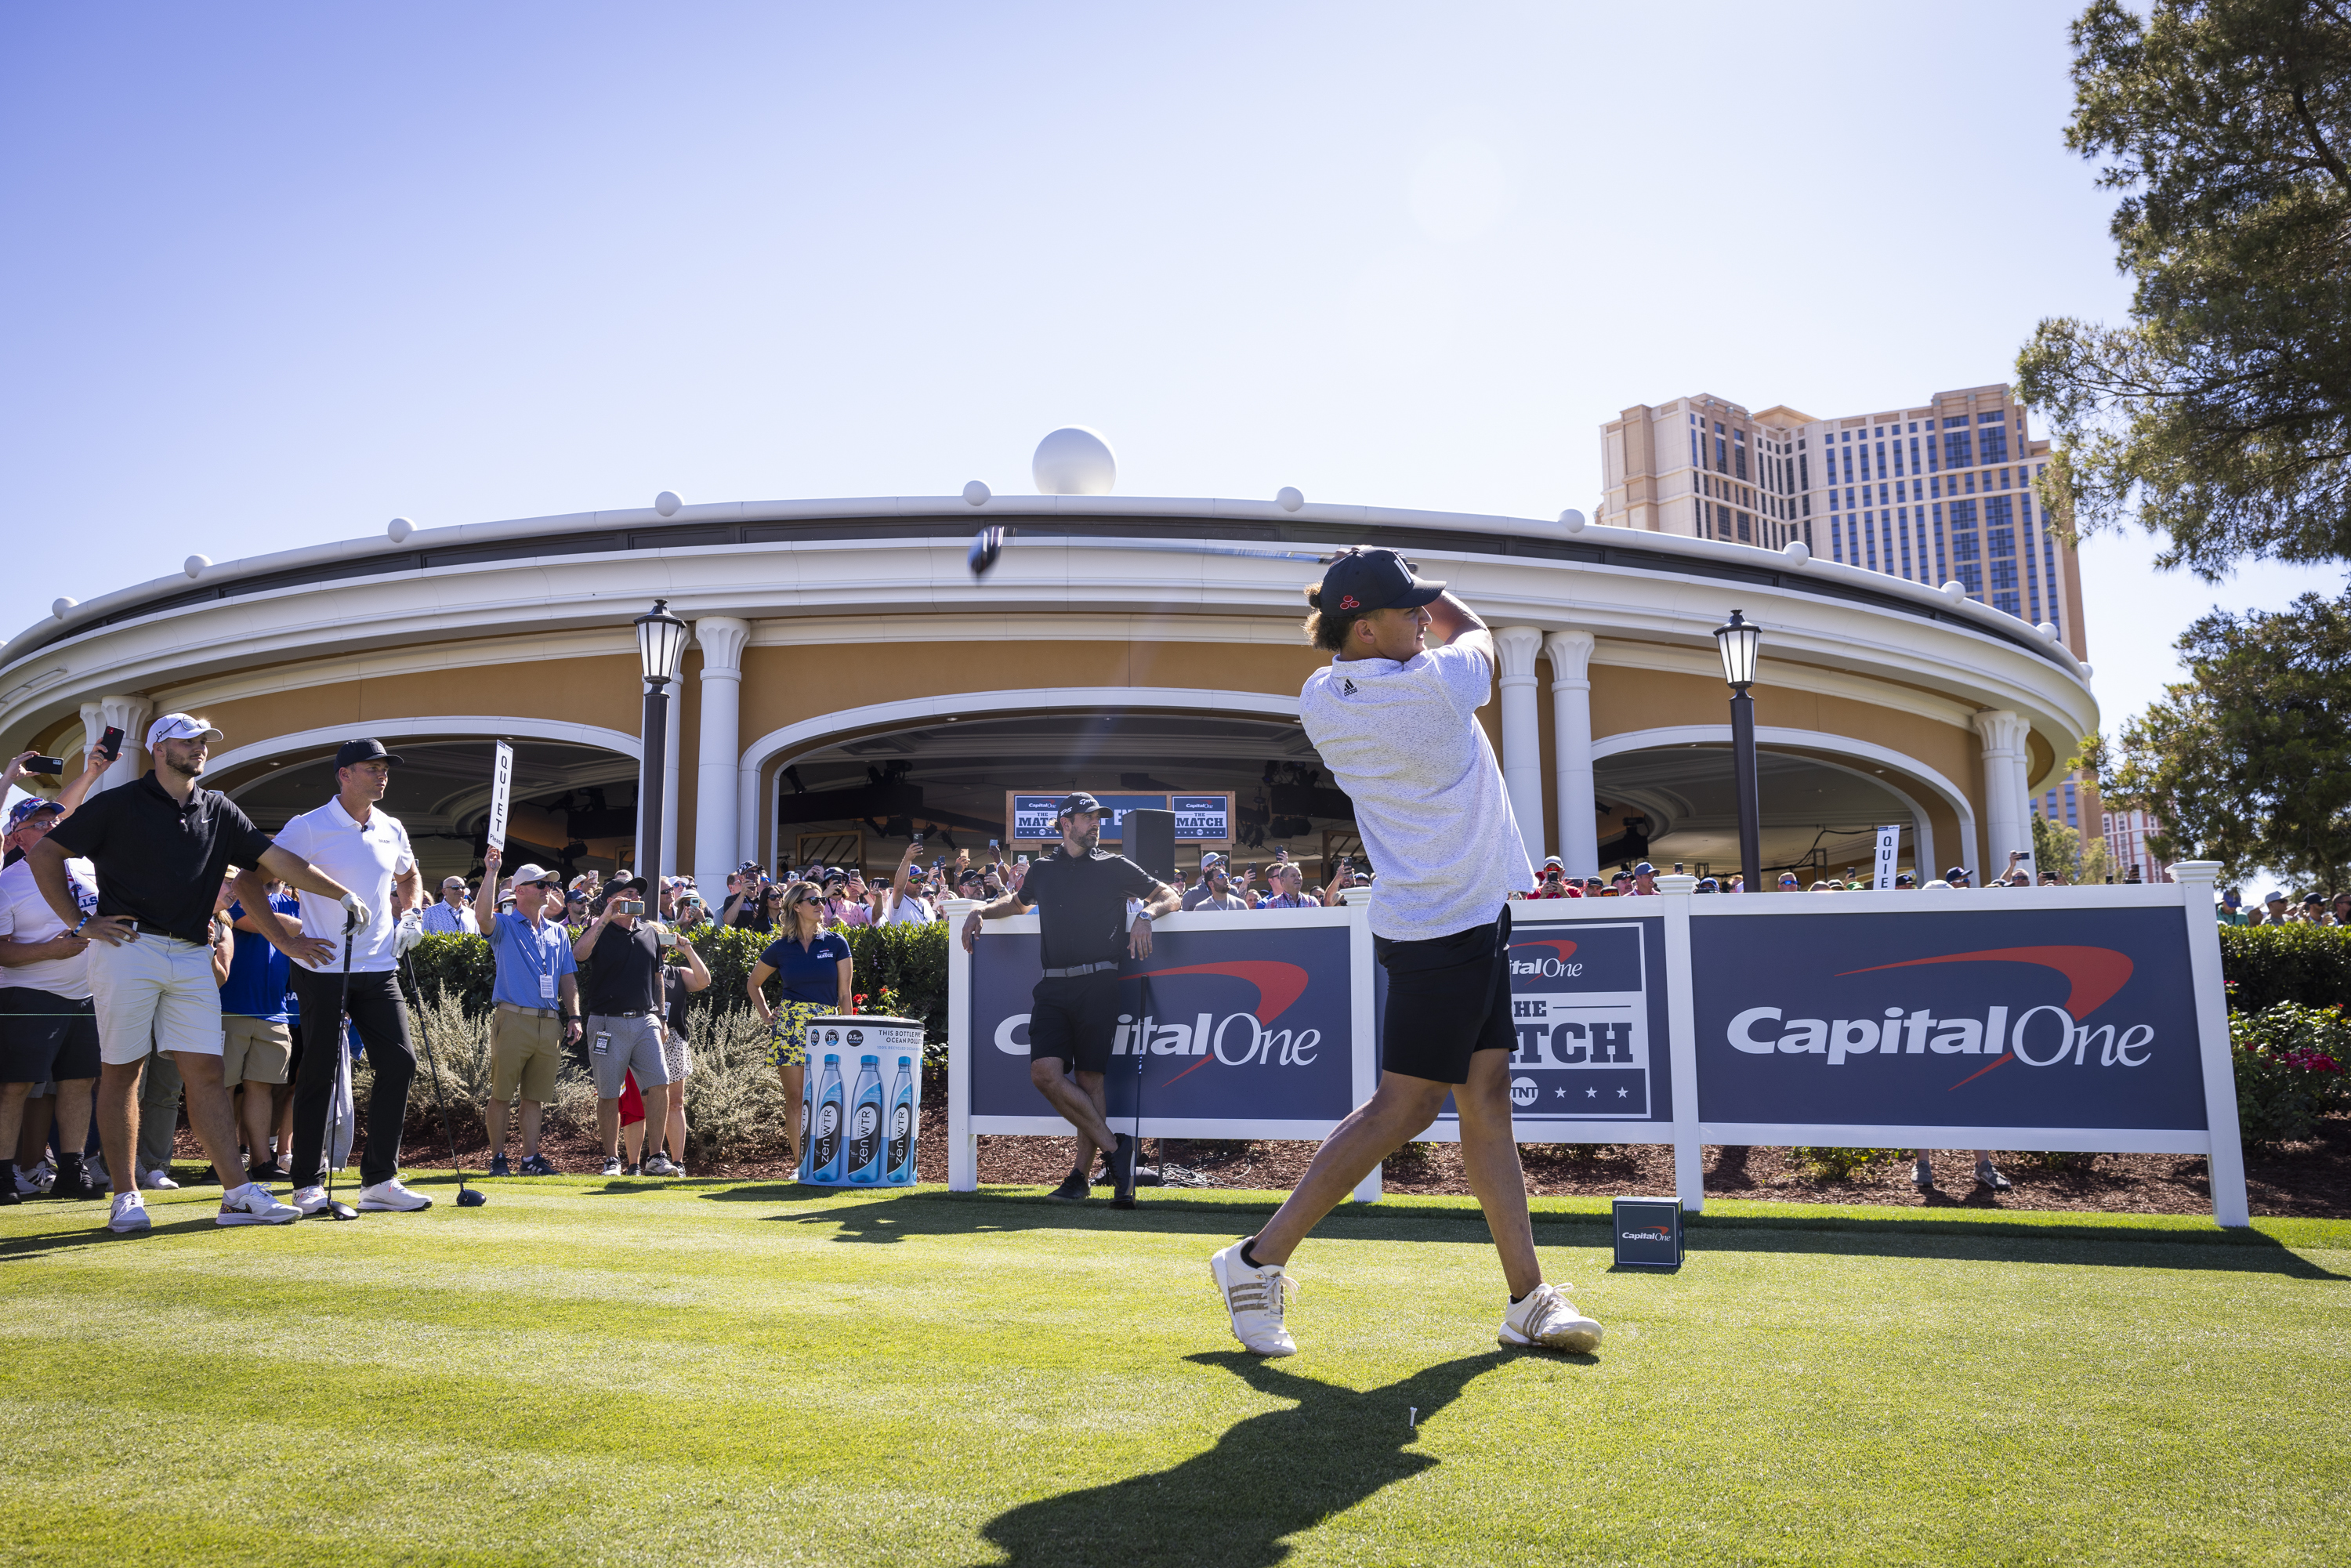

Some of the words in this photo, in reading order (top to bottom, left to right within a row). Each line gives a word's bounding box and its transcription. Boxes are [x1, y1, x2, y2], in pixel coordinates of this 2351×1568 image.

[1344, 687, 1358, 697] adidas
[496, 755, 507, 831] QUIET
[1176, 818, 1223, 826] MATCH
[489, 833, 504, 846] Please
[1881, 836, 1892, 888] QUIE
[1512, 1001, 1547, 1017] HE
[994, 1013, 1321, 1066] CitalOne
[1509, 1022, 1633, 1064] TCH
[1511, 1087, 1538, 1098] TNT
[823, 1110, 831, 1135] WTR
[861, 1111, 870, 1136] WTR
[821, 1139, 830, 1162] zen
[859, 1140, 869, 1164] zen
